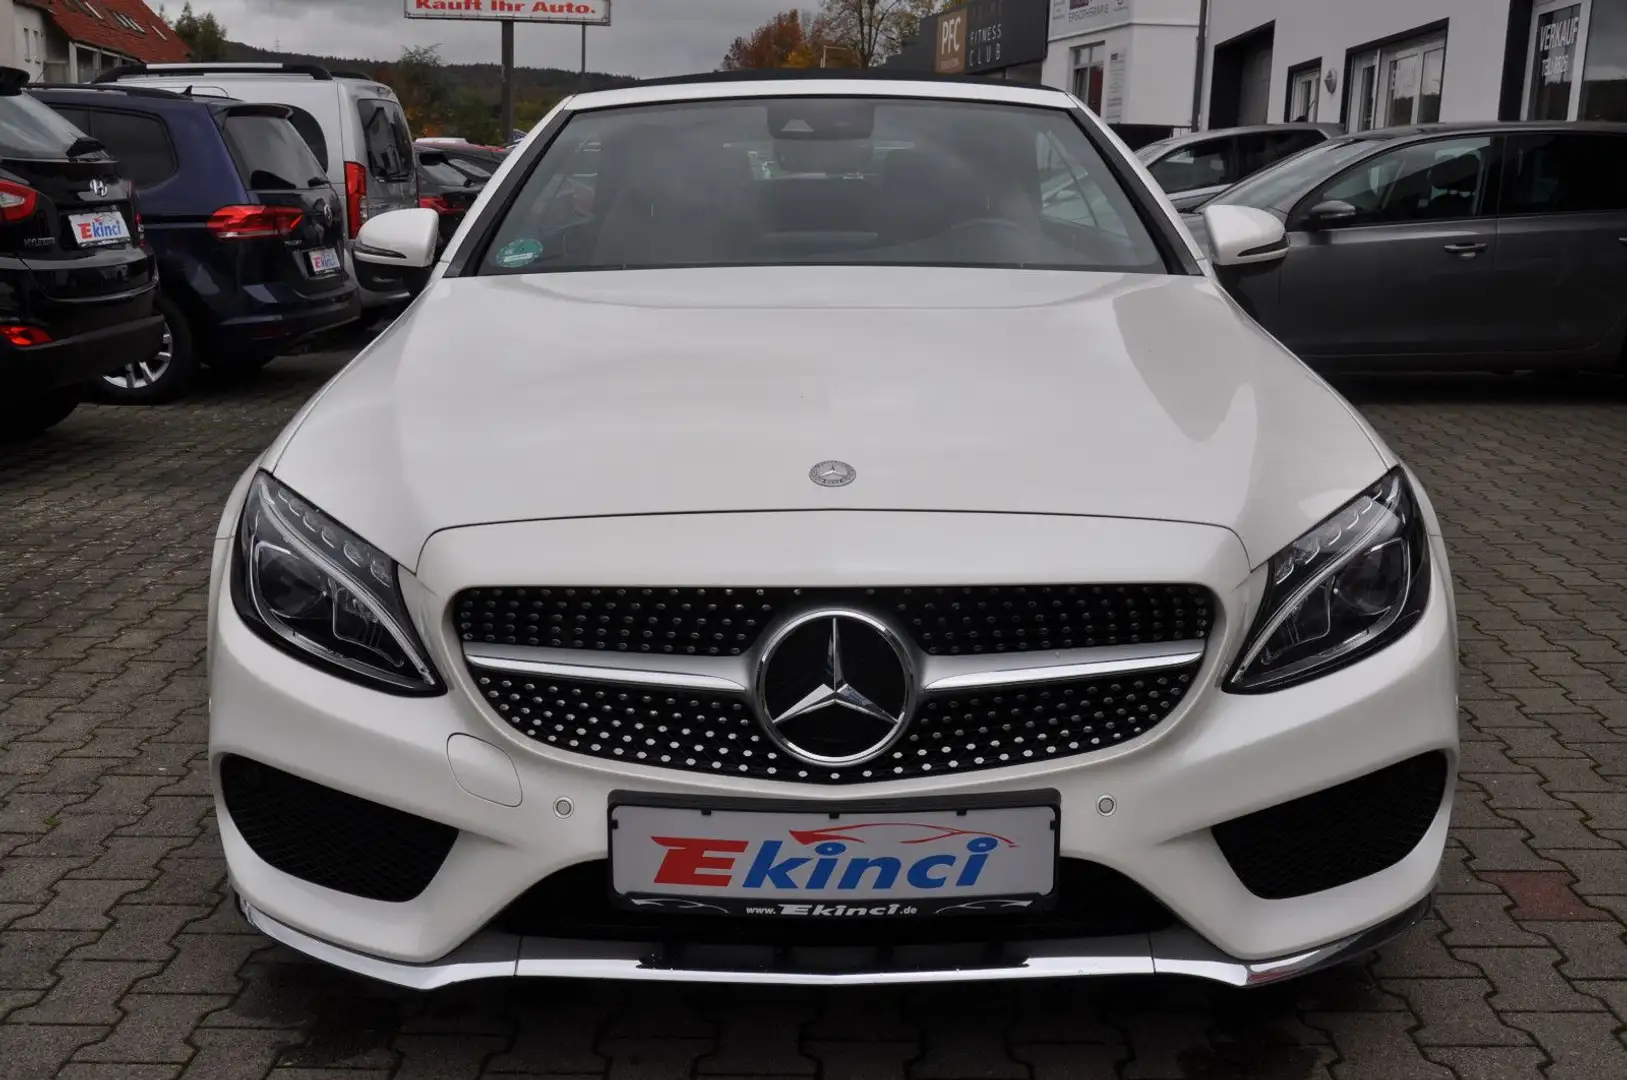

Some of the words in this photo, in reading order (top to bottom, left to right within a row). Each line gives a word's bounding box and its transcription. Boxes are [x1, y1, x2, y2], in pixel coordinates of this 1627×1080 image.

[416, 0, 482, 10] Kauft
[491, 0, 525, 12] Ihr
[532, 1, 596, 14] Auto.
[941, 17, 961, 55] PFC
[970, 24, 1002, 45] FITNESS
[1540, 17, 1579, 51] VERKAUF
[77, 219, 121, 239] Ekinci
[650, 836, 999, 890] Ekinci
[746, 903, 917, 916] www.Ekinci.de
